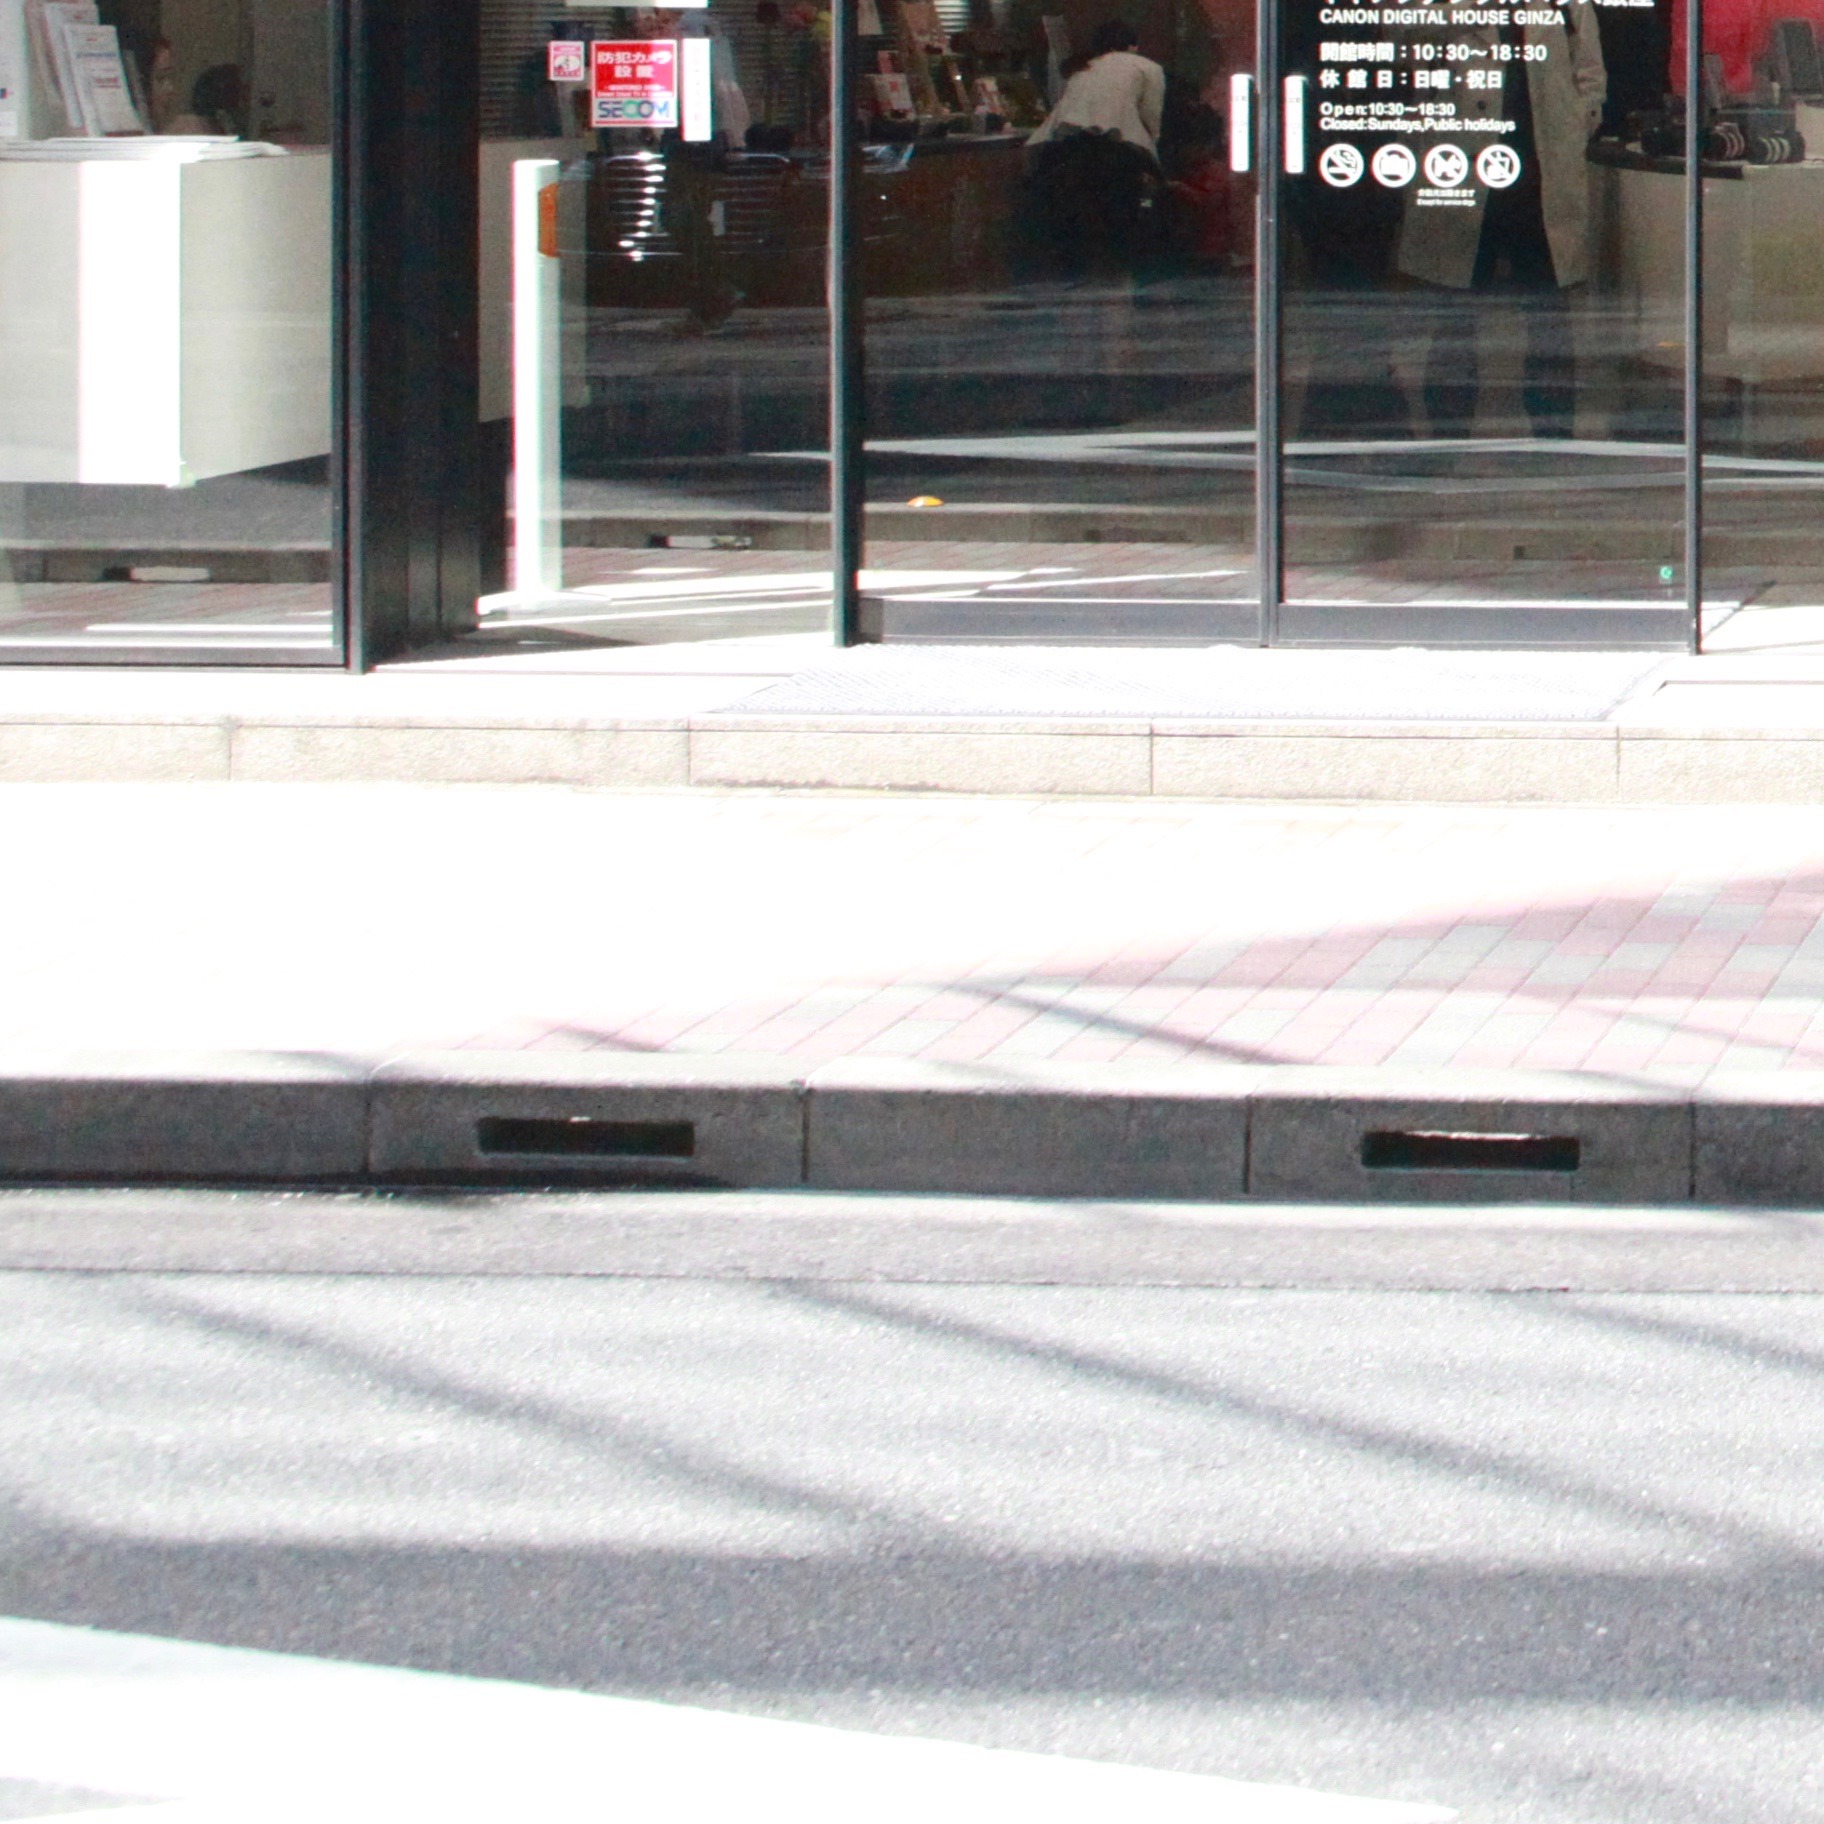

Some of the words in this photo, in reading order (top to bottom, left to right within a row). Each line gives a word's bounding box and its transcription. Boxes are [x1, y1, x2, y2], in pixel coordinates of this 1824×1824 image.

[1319, 9, 1379, 25] CANON
[1383, 9, 1447, 25] DIGITAL
[1452, 9, 1510, 25] HOUSE
[1514, 9, 1565, 25] GINZA
[598, 100, 670, 118] SECOM
[1464, 118, 1516, 134] holidays
